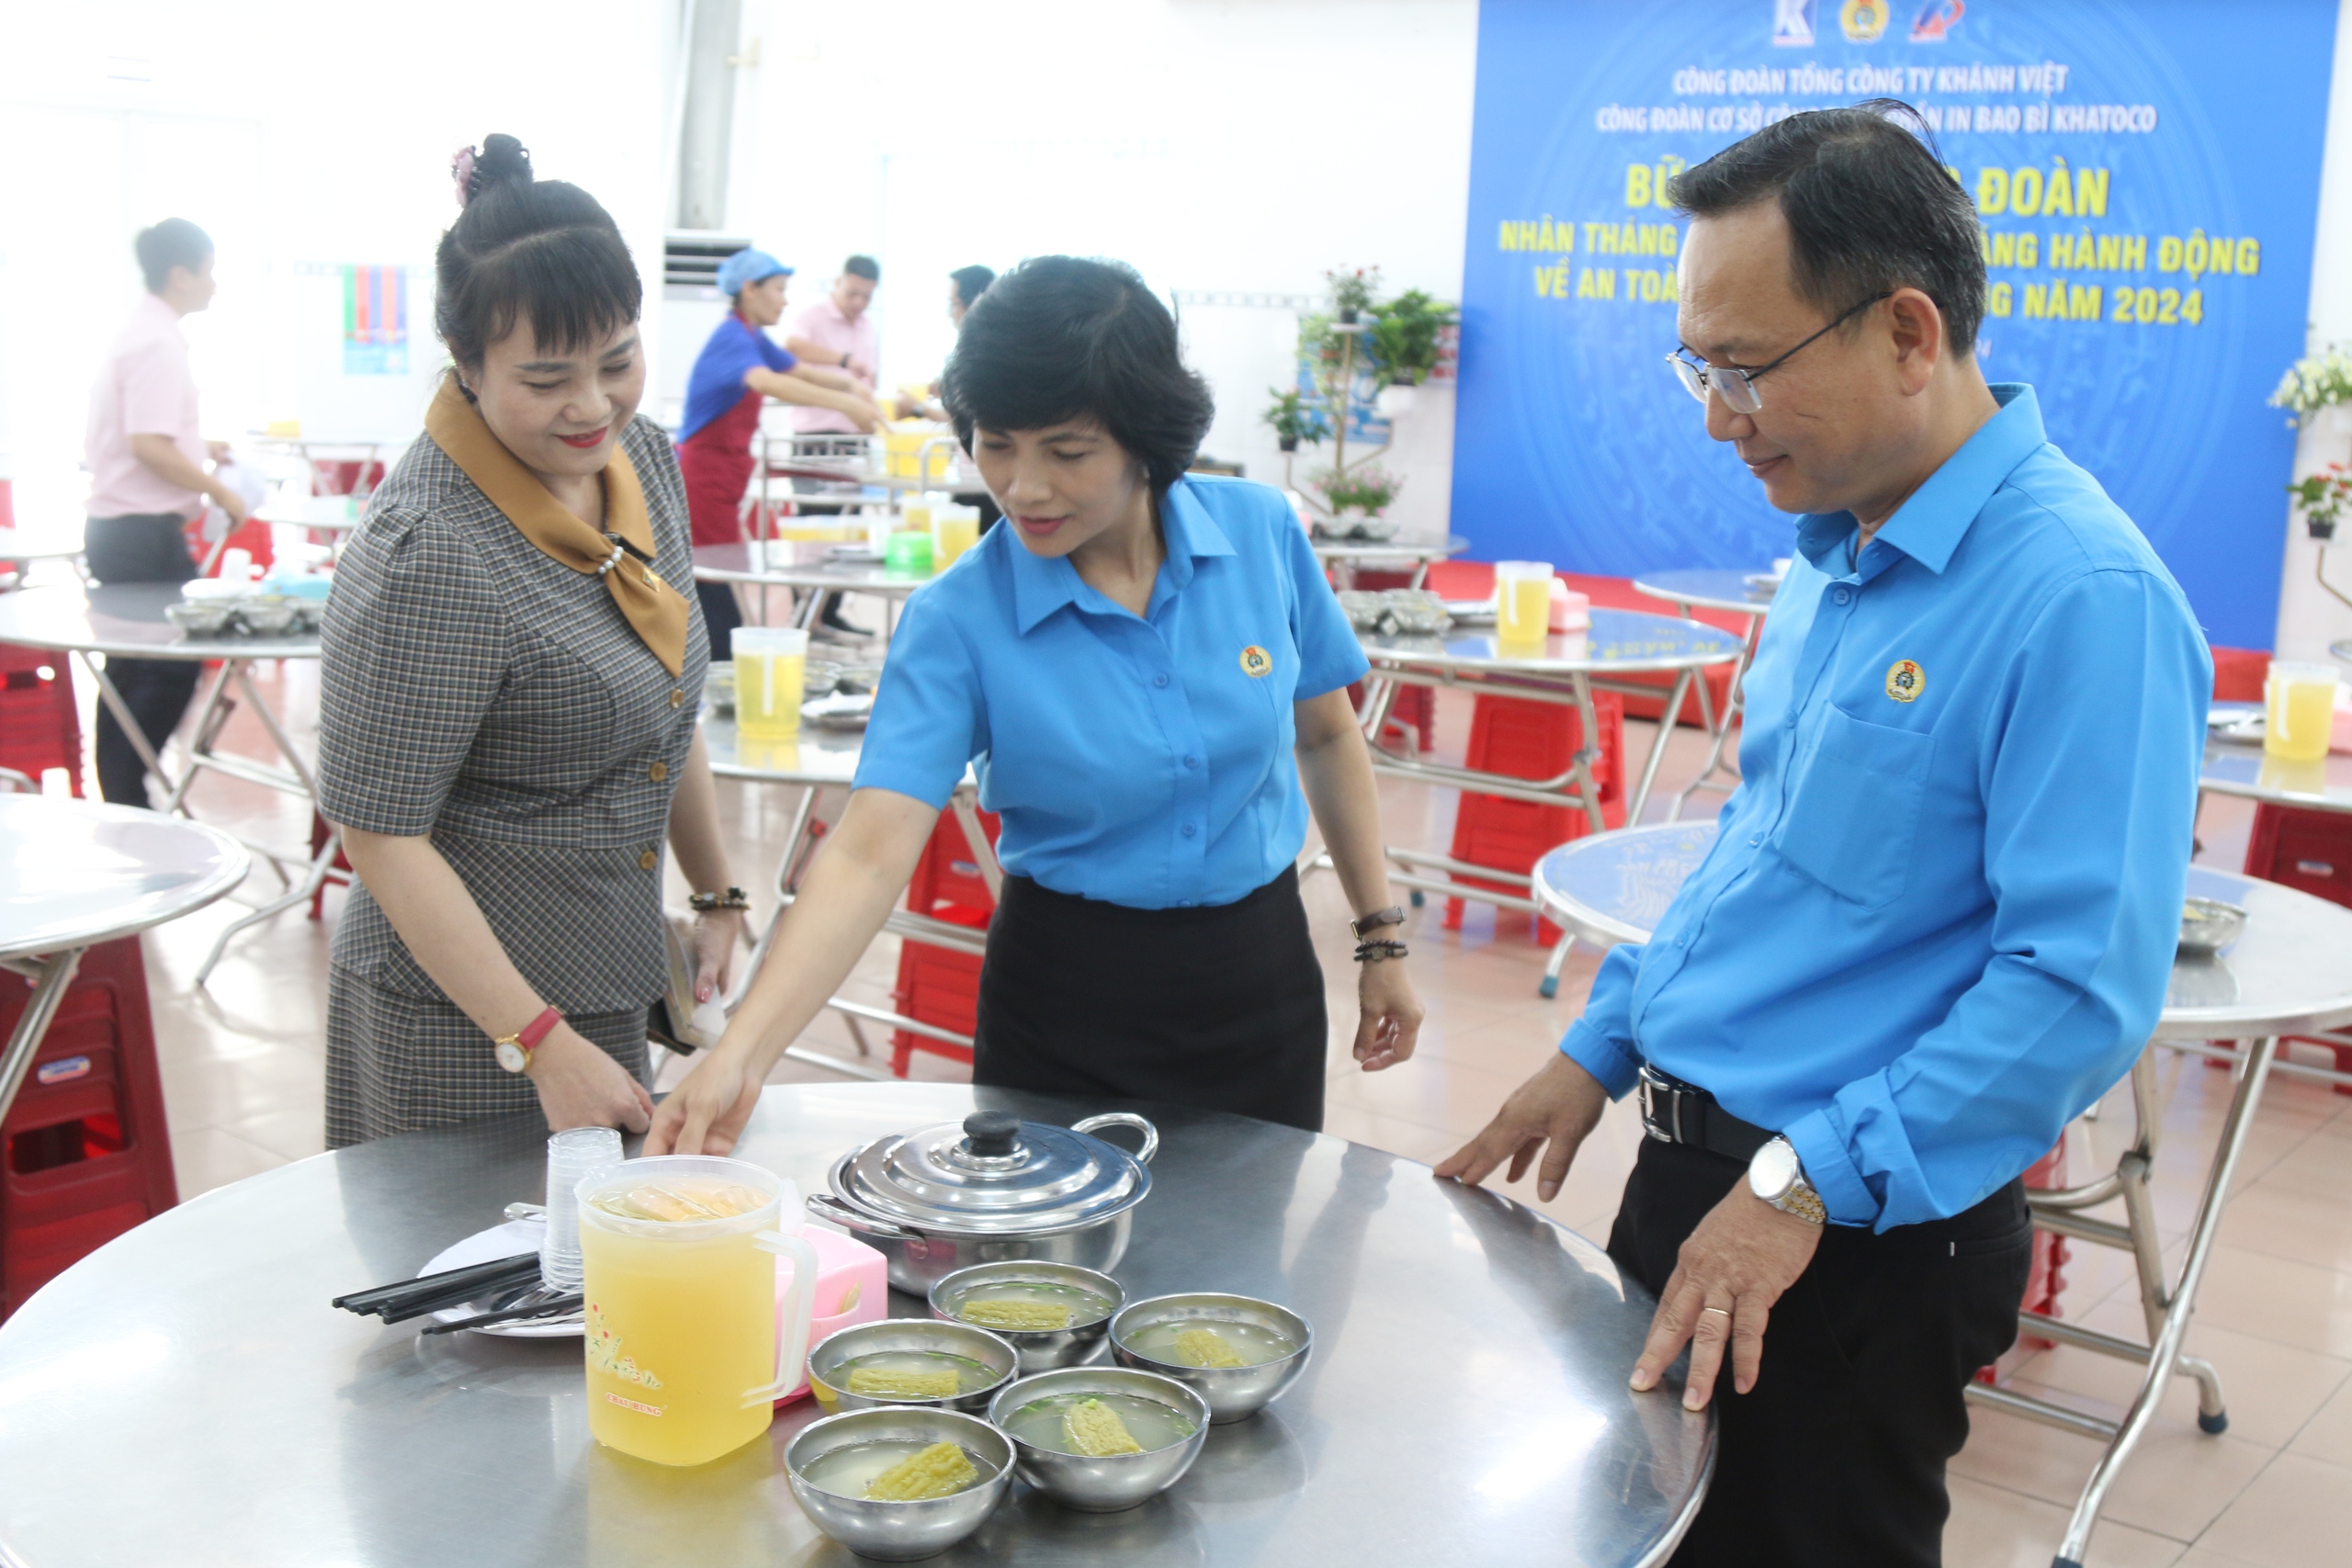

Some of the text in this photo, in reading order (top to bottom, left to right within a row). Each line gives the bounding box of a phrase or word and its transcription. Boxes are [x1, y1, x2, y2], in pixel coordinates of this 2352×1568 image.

[1673, 59, 2069, 99] CÔNG ĐOÀN TỔNG CÔNG TY KHÁNH VIỆT
[1597, 103, 1647, 132] CÔNG
[1650, 102, 1704, 132] ĐOÀN
[1707, 106, 1735, 132] CƠ
[1736, 100, 1764, 132] SỞ
[1945, 105, 1973, 132] IN
[1975, 105, 2021, 133] BAO
[2024, 99, 2050, 132] BÌ
[2052, 104, 2157, 133] KHATOCO
[1977, 155, 2109, 217] ĐOÀN
[1499, 214, 1575, 252] NHÂN
[1584, 216, 1678, 257] THÁNG
[2050, 225, 2147, 271] HÀNH
[2158, 228, 2261, 282] ĐỘNG
[1534, 255, 1570, 299] VỀ
[1577, 267, 1616, 299] AN
[1624, 263, 1679, 303] TOÀ
[2024, 277, 2102, 321] NĂM
[2112, 286, 2203, 325] 2024
